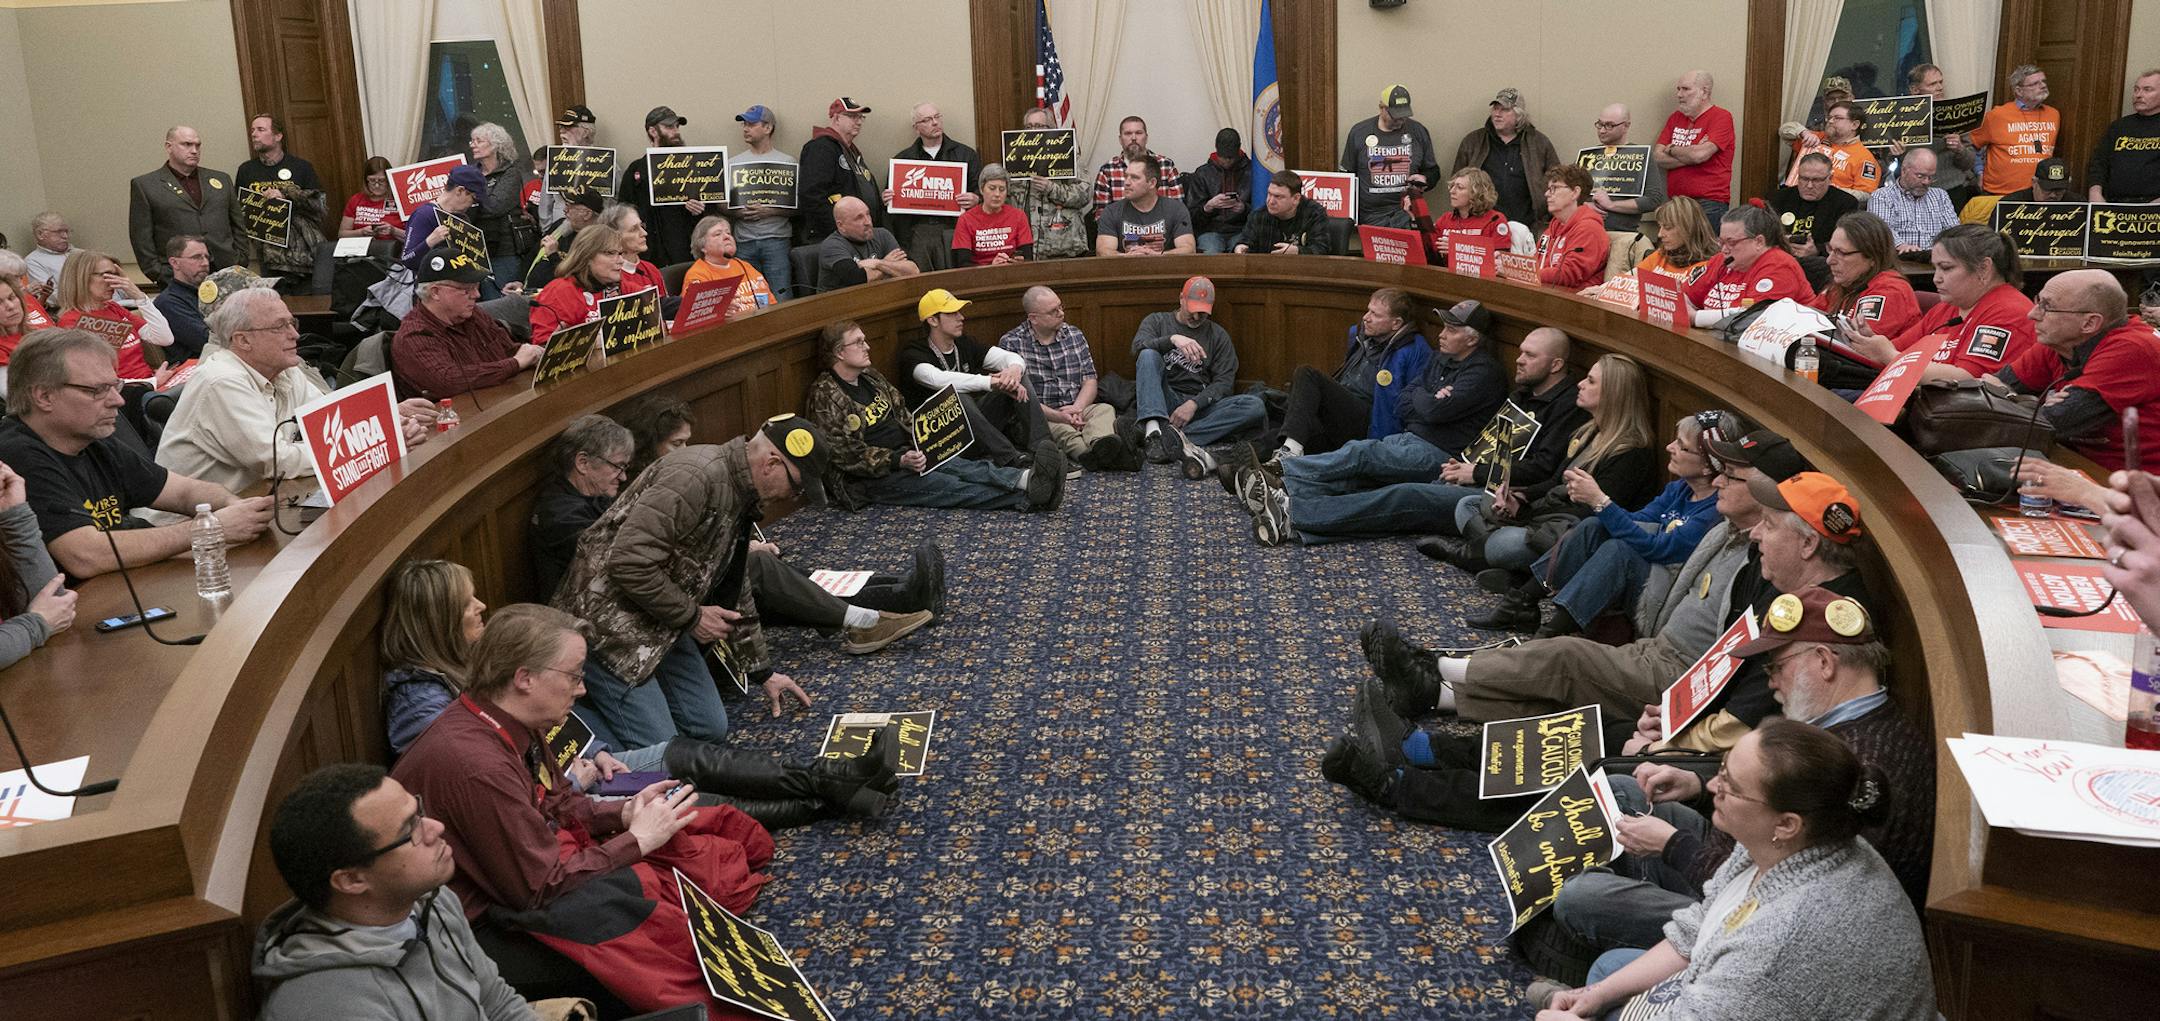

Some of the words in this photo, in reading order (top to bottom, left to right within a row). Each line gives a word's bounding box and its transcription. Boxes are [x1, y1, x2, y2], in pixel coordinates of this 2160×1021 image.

[1900, 98, 1927, 113] not
[1936, 104, 1953, 112] GUN
[1954, 97, 1985, 110] OWNERS
[1936, 104, 1983, 121] CAUCUS
[1873, 112, 1930, 136] infringed
[1010, 132, 1043, 147] Shall
[1046, 131, 1071, 145] not
[2126, 142, 2160, 150] CAUCU
[554, 148, 584, 162] Shall
[586, 151, 611, 163] not
[1006, 147, 1017, 161] be
[1022, 146, 1074, 168] infringed
[1368, 146, 1398, 157] DEFEND
[1398, 144, 1411, 155] THE
[2008, 145, 2036, 155] GETTIN
[657, 153, 694, 169] Shall
[696, 153, 720, 168] not
[1595, 161, 1643, 171] CAUCUS
[549, 162, 560, 176] be
[562, 163, 614, 185] infringed
[653, 170, 666, 185] be
[672, 168, 724, 192] infringed
[750, 168, 764, 176] GUN
[765, 168, 795, 177] OWNERS
[425, 173, 451, 190] NR
[749, 175, 794, 187] CAUCUS
[922, 176, 954, 191] NRA
[407, 190, 433, 204] STAND
[901, 187, 924, 198] STAND
[934, 190, 955, 200] FIGHT
[1313, 187, 1342, 200] NRA
[2005, 204, 2048, 221] Shall
[2050, 206, 2085, 221] not
[2117, 212, 2138, 221] GUN
[2140, 213, 2160, 221] OWN
[1123, 222, 1150, 235] DEFEND
[1151, 220, 1165, 234] THE
[2018, 221, 2087, 246] infringed
[2117, 222, 2158, 234] CAUC
[1371, 236, 1395, 247] MOMS
[1455, 243, 1475, 254] MOMS
[1373, 245, 1407, 256] DEMAND
[1375, 253, 1406, 263] ACTION
[1455, 253, 1483, 265] DEMAND
[1502, 254, 1537, 272] PROTECT
[1455, 262, 1480, 273] ACTION
[1607, 275, 1639, 293] PROTEC
[1645, 282, 1665, 297] MOMS
[608, 298, 640, 324] Shall
[643, 292, 656, 315] not
[1646, 294, 1676, 312] DEMAND
[1648, 306, 1673, 321] ACTION
[76, 315, 133, 334] PROTECT
[605, 325, 618, 349] be
[927, 408, 940, 420] GUN
[939, 392, 957, 410] OWNERS
[930, 403, 962, 433] CAUCUS
[343, 415, 387, 457] NRA
[332, 459, 362, 491] STAND
[367, 442, 391, 472] FIGHT
[2040, 573, 2081, 607] ACTION
[899, 718, 927, 747] Shall
[1567, 731, 1582, 748] GUN
[1541, 735, 1565, 786] CAUCUS
[1527, 810, 1559, 832] be
[1559, 795, 1604, 846] Shall
[1528, 841, 1577, 905] infring
